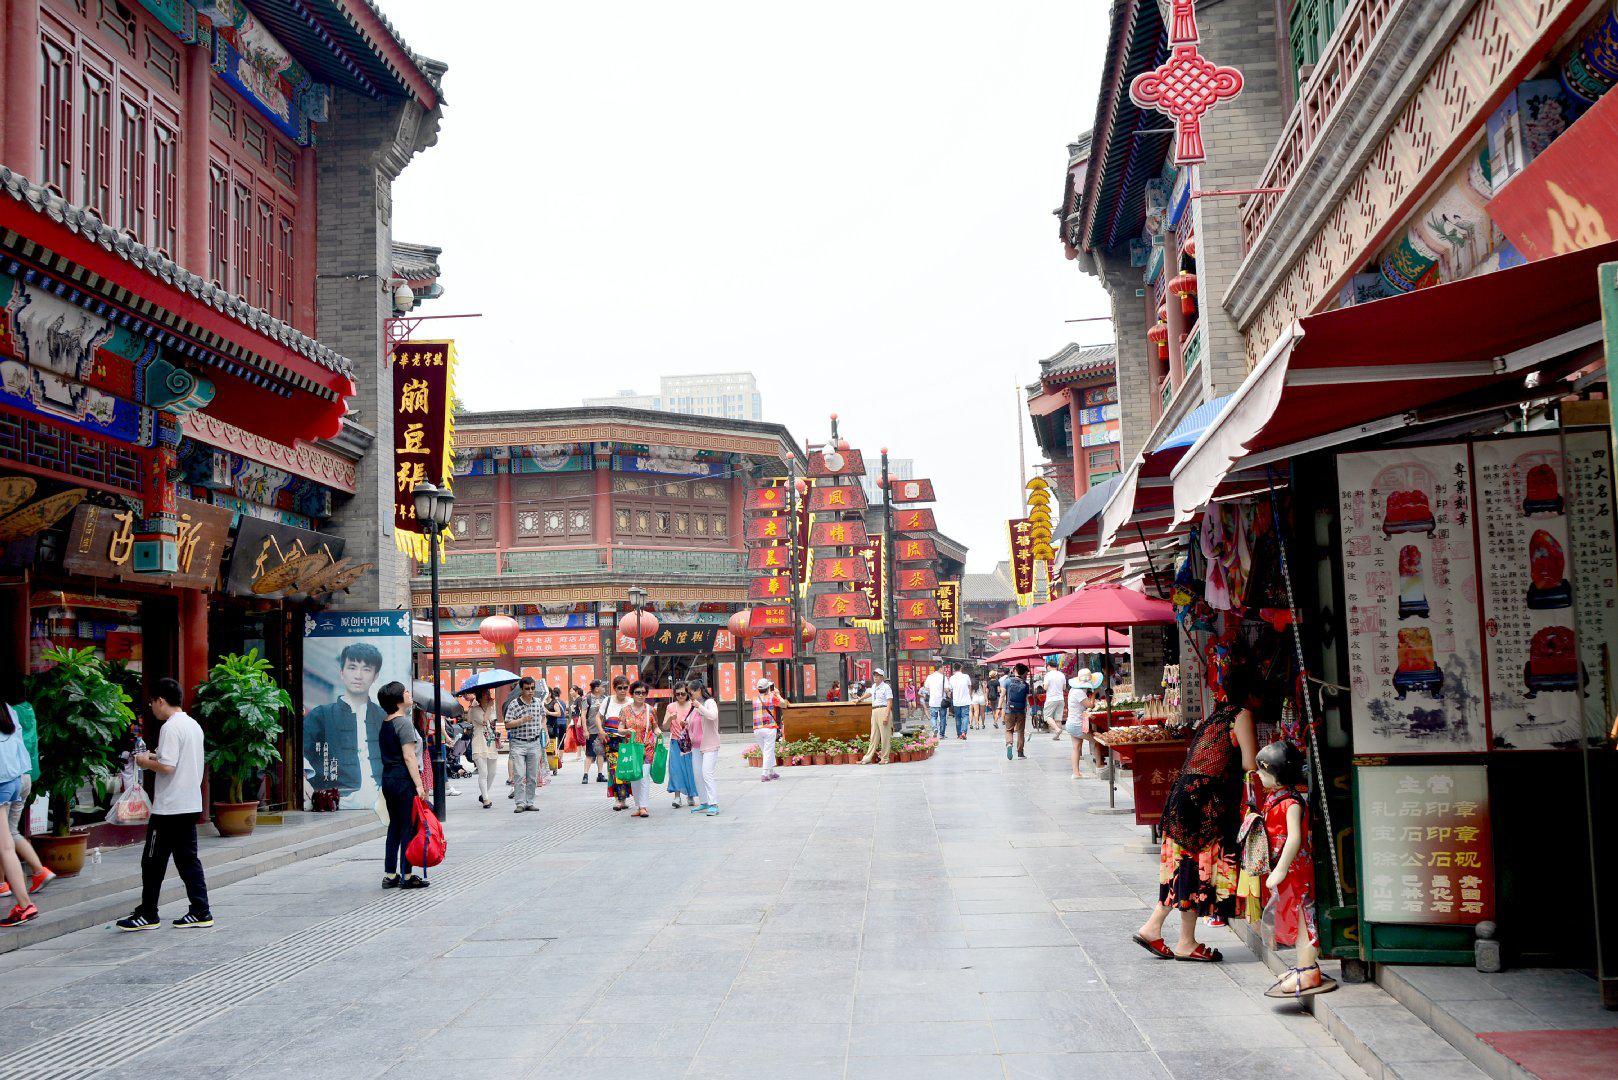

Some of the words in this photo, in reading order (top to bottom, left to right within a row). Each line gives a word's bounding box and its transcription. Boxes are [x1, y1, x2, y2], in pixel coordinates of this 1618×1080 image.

[1591, 449, 1610, 518] 四大名石
[340, 616, 391, 627] 原创中国风
[1371, 800, 1481, 818] 礼品印章
[1372, 825, 1480, 843] 宝石印章
[1372, 851, 1482, 868] 徐公石砚
[1429, 874, 1454, 914] 昌化石
[1458, 875, 1484, 914] 青田石
